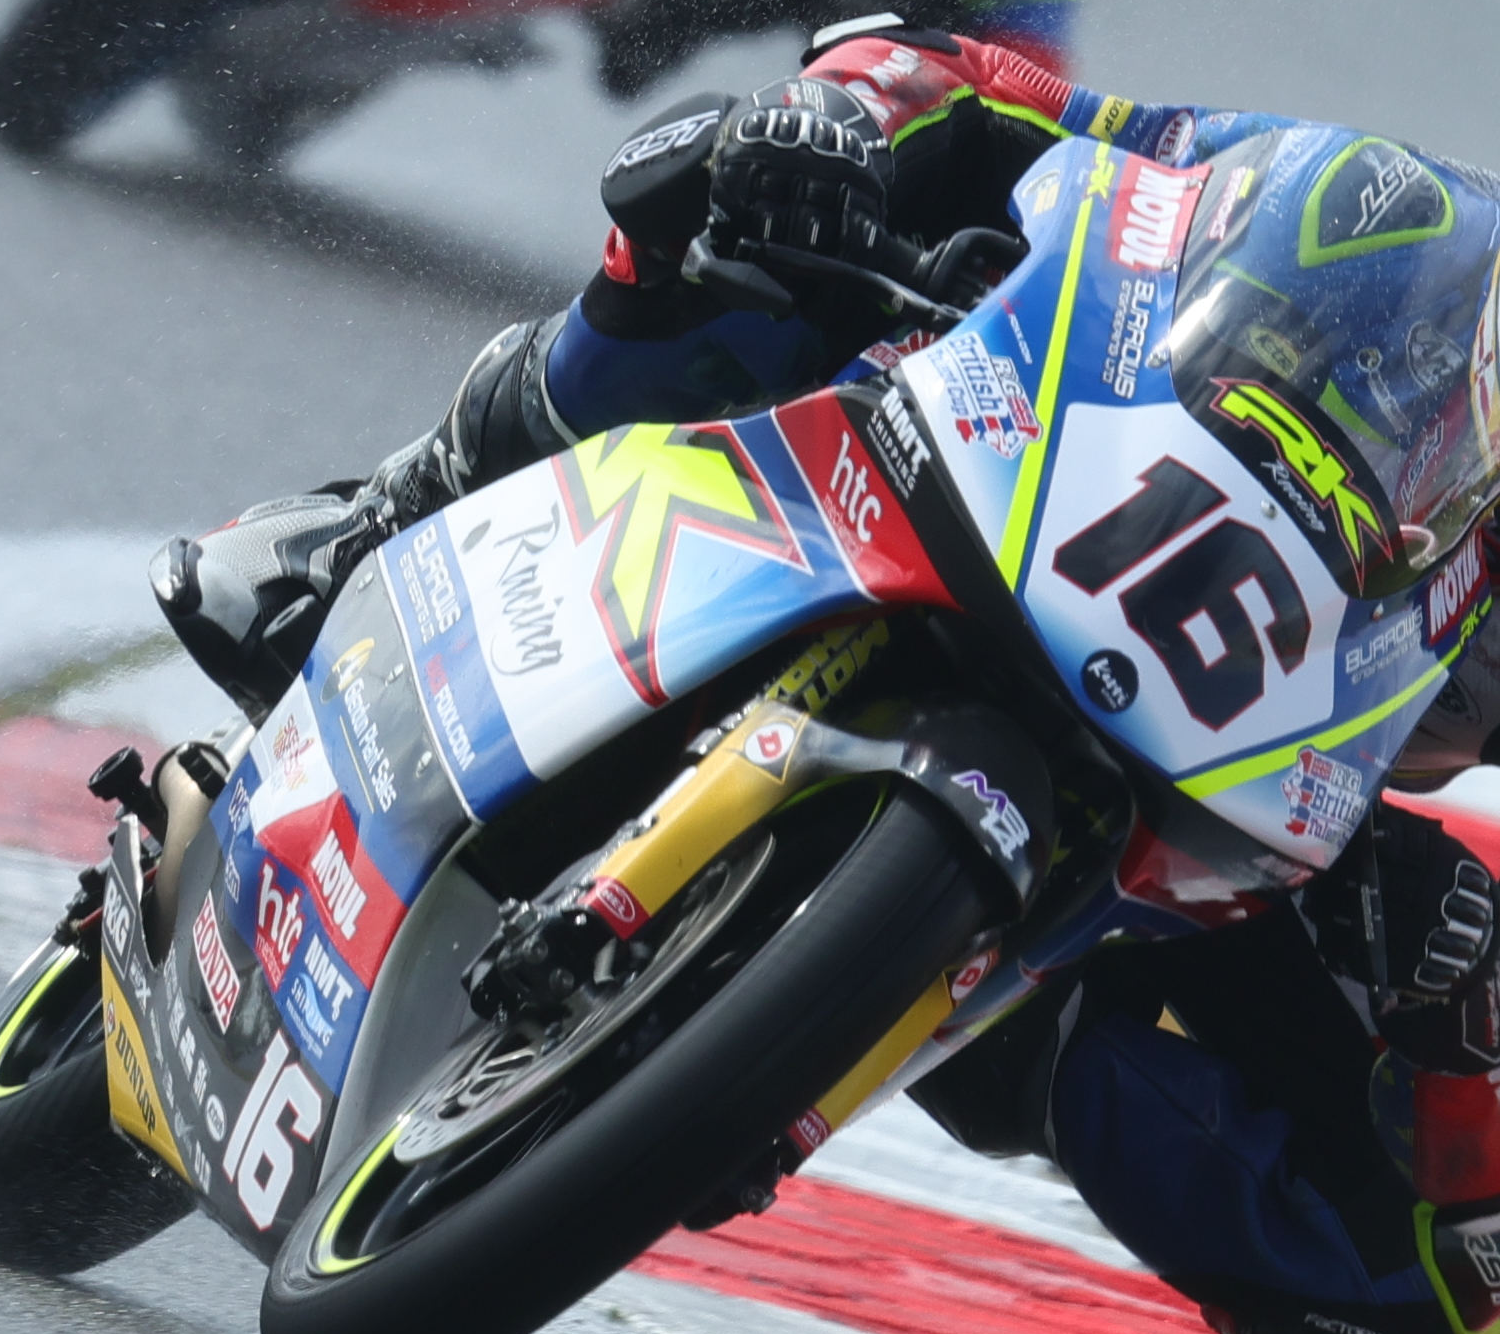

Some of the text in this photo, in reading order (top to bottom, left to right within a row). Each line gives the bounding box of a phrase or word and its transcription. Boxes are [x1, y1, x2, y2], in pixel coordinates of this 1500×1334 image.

[604, 109, 720, 178] RST
[1118, 165, 1189, 268] MOTUL
[950, 335, 1002, 417] British
[1113, 278, 1155, 399] BURROWS
[869, 411, 917, 491] SHIPPING
[881, 386, 932, 475] NMT
[830, 430, 882, 544] htc
[412, 523, 461, 634] BURROWS
[1052, 454, 1313, 734] 16
[1429, 537, 1481, 637] MOTUL
[1345, 604, 1424, 675] BURROWS
[102, 876, 134, 958] R&G
[258, 861, 303, 965] htc
[311, 829, 367, 940] MOTUL
[196, 900, 237, 1027] HONDA
[304, 932, 353, 1022] NMT
[114, 1018, 156, 1135] DUNLOP
[222, 1029, 323, 1230] 16
